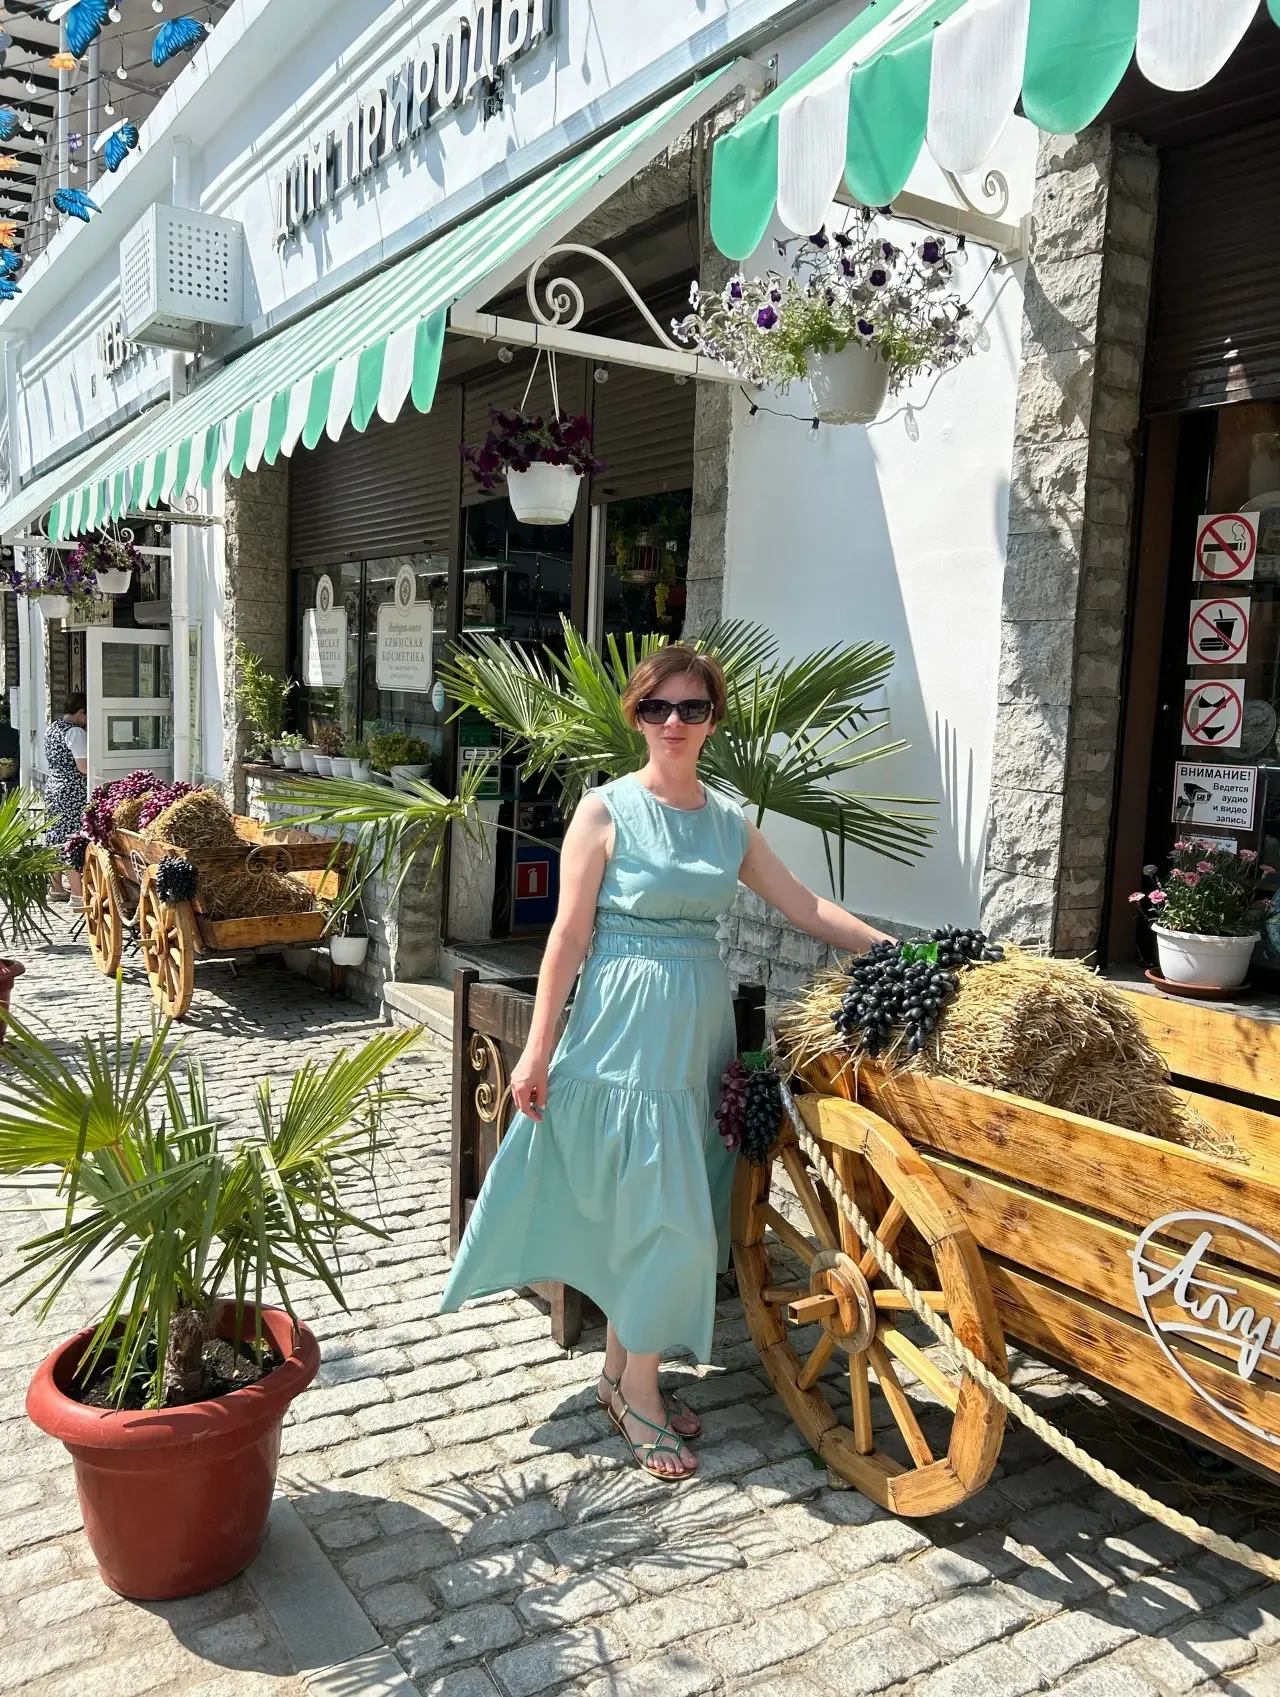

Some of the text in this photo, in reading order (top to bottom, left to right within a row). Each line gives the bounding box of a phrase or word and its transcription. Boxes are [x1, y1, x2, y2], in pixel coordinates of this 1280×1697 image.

[271, 129, 332, 253] ДОМ
[383, 637, 424, 648] КРЫМСКАЯ
[381, 650, 425, 663] КОСМЕТИКА
[1180, 766, 1251, 781] ВНИМАНИЕ!
[1213, 782, 1249, 793] Ведется
[1222, 794, 1249, 804] аудио
[1220, 804, 1248, 814] видео
[1215, 815, 1247, 825] запись
